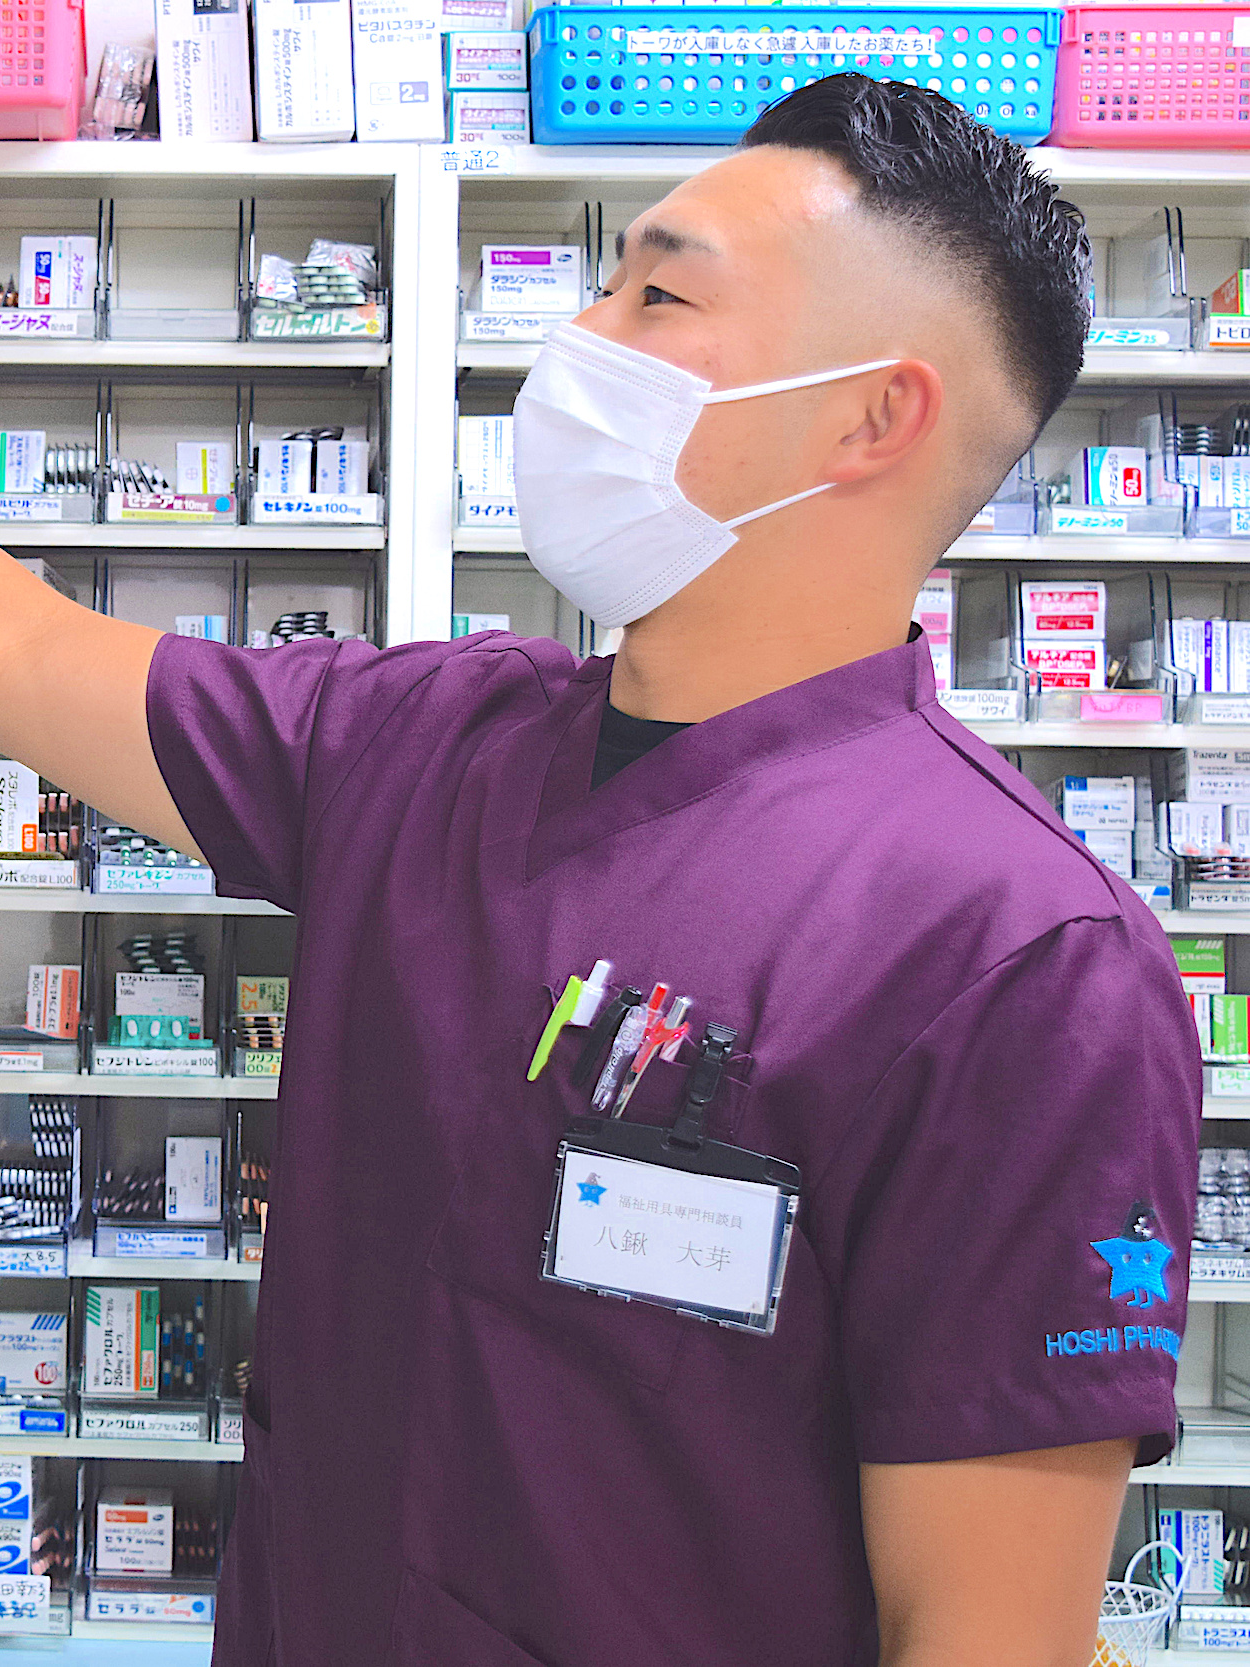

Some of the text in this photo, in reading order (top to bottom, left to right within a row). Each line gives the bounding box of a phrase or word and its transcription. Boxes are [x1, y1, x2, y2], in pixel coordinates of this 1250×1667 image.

[441, 151, 500, 171] 普通2
[491, 274, 557, 285] ダラシンカプセル
[491, 285, 523, 294] 150mg
[473, 316, 541, 327] ダラシンカプセル
[473, 327, 506, 336] 150mg
[264, 501, 362, 516] セレキノン錠100mg
[618, 1194, 743, 1230] 福祉用具専門相談員
[594, 1225, 732, 1272] 八鍬 大芽
[1046, 1327, 1119, 1357] HOSHI
